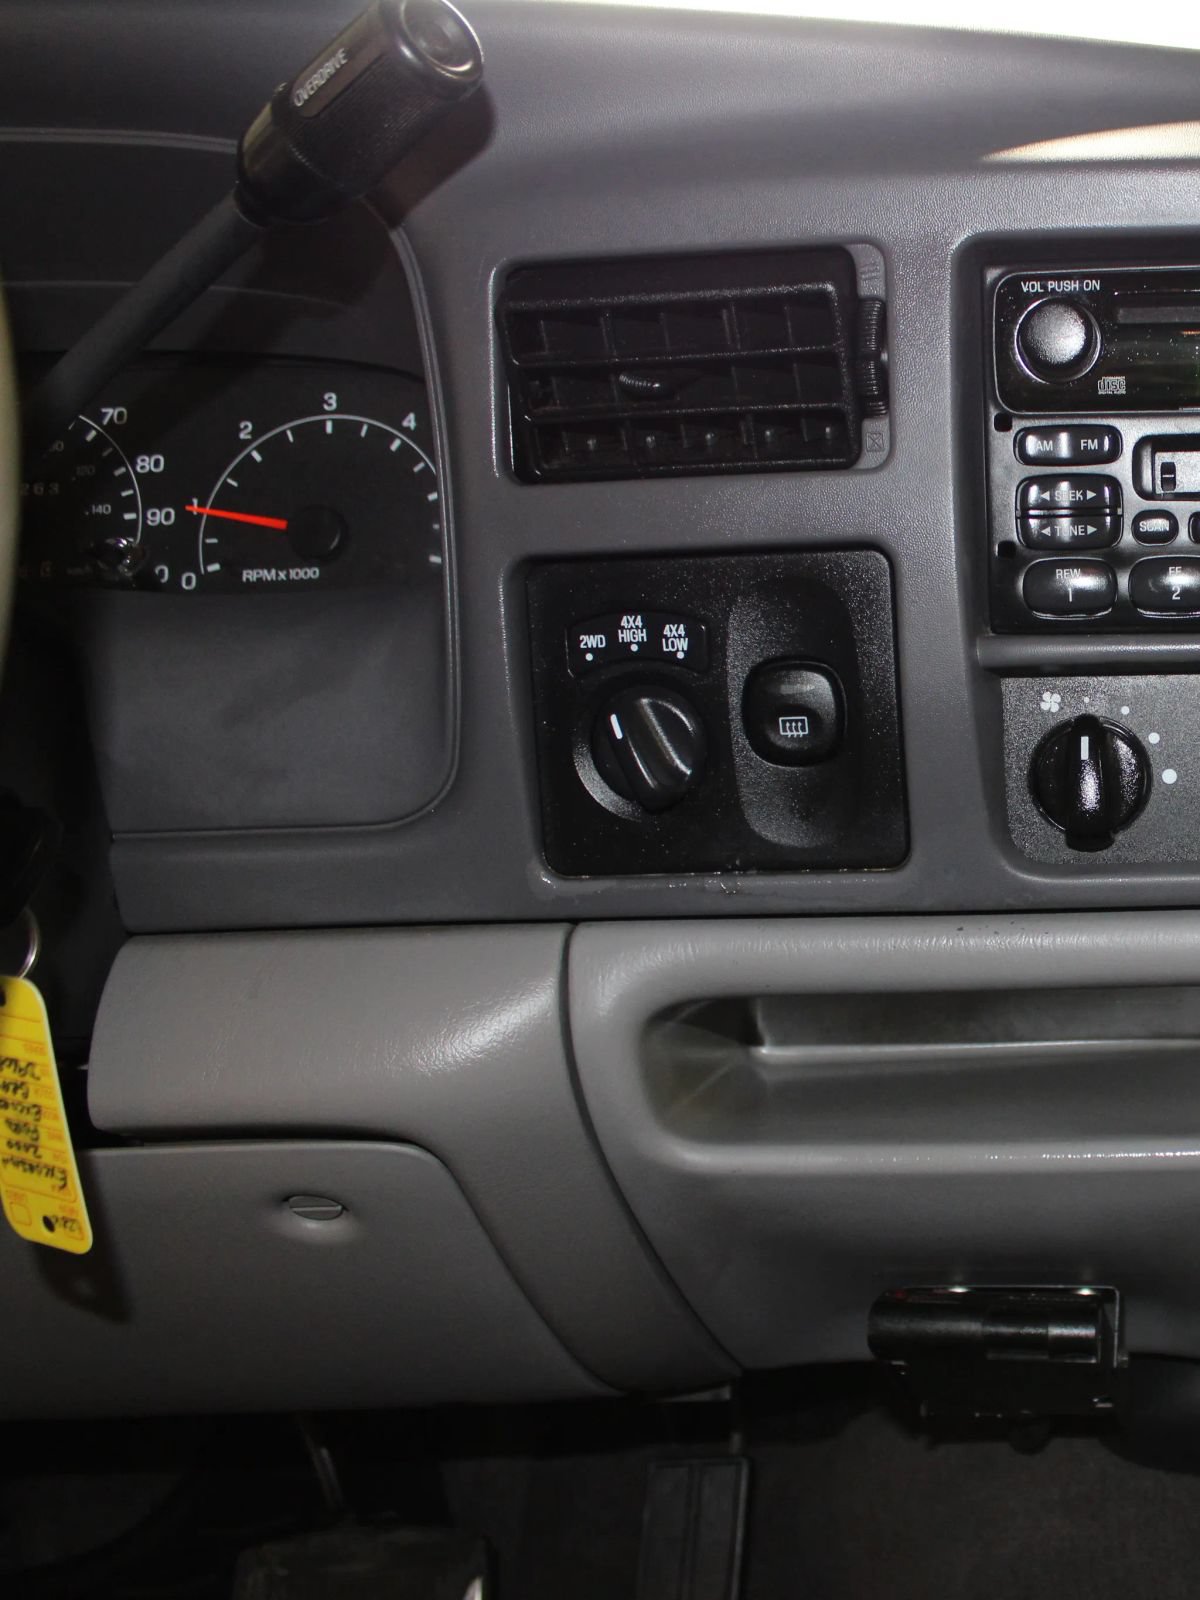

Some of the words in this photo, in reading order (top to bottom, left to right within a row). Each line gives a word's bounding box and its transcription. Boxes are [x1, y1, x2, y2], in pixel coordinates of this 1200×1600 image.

[293, 48, 348, 107] OVERDRIVE
[1021, 280, 1045, 293] VOL
[1048, 279, 1080, 293] PUSH
[1082, 279, 1101, 292] ON
[323, 392, 338, 411] 3
[100, 407, 128, 426] 70
[402, 412, 418, 431] 4
[239, 421, 253, 440] 2
[1036, 440, 1054, 452] AM
[1080, 439, 1099, 451] FM
[135, 455, 165, 474] 80
[1054, 490, 1084, 502] SEEK
[91, 503, 112, 516] 140
[146, 507, 175, 526] 90
[1139, 520, 1170, 533] SCAN
[181, 571, 197, 590] 0
[1055, 567, 1081, 580] REW
[1067, 587, 1073, 602] 1
[1171, 586, 1181, 600] 2
[620, 615, 643, 629] 4X4
[618, 628, 647, 643] HIGH
[663, 624, 686, 638] 4X4
[579, 635, 606, 648] 2WD
[662, 637, 689, 651] LOW
